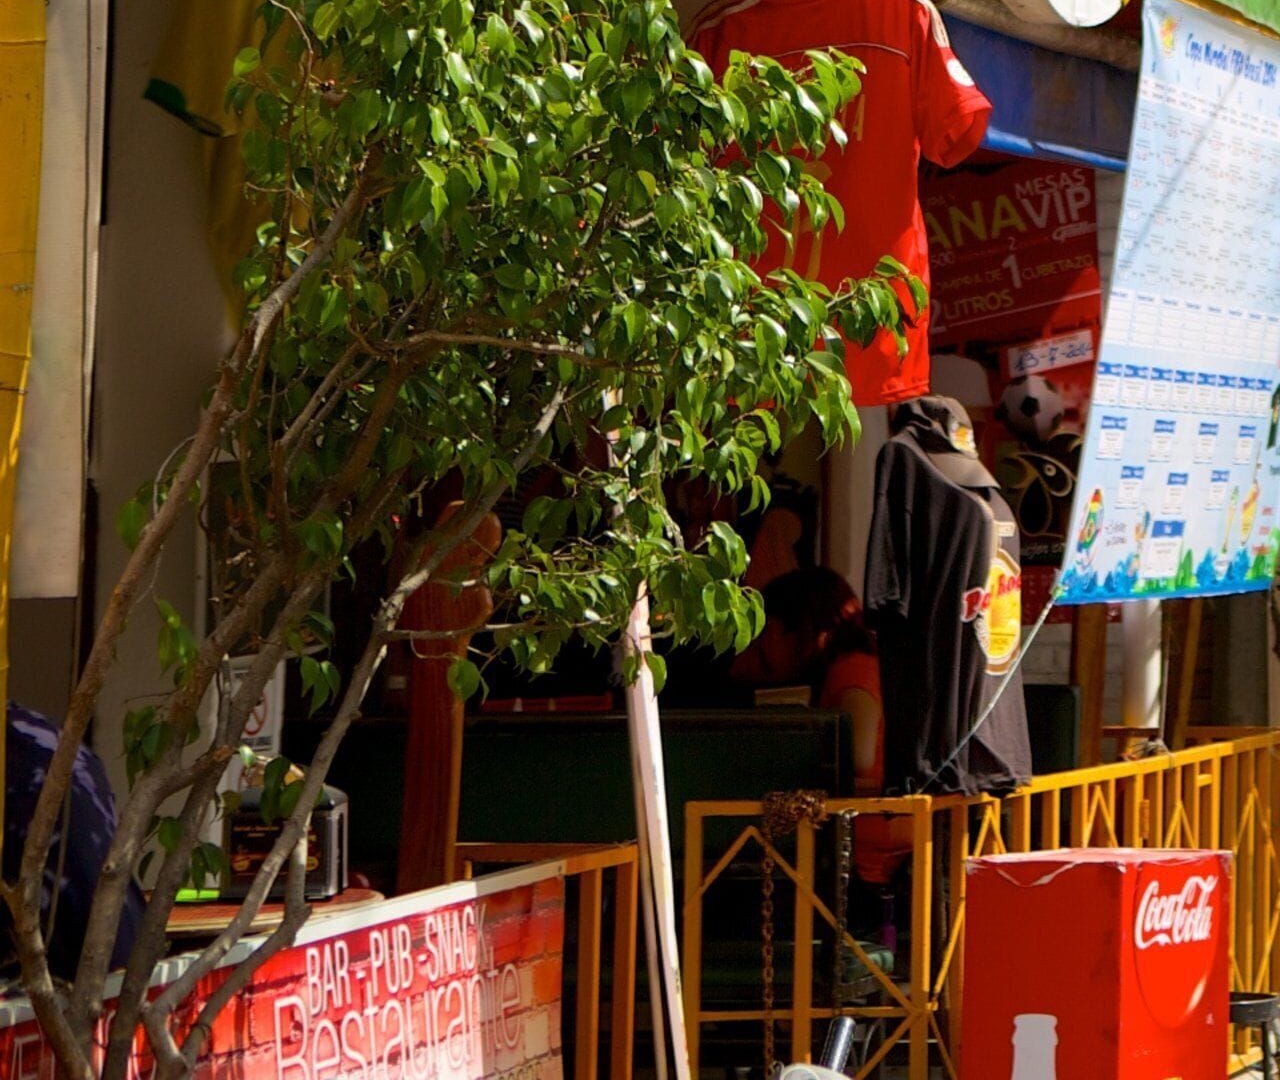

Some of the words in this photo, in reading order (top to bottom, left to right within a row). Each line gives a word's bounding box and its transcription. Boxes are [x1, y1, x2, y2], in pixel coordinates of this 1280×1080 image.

[1014, 167, 1087, 200] MESAS
[926, 193, 1028, 250] ANA
[1019, 183, 1092, 229] VIP
[942, 289, 1015, 321] LITROS
[1134, 874, 1219, 950] Coca-Cola
